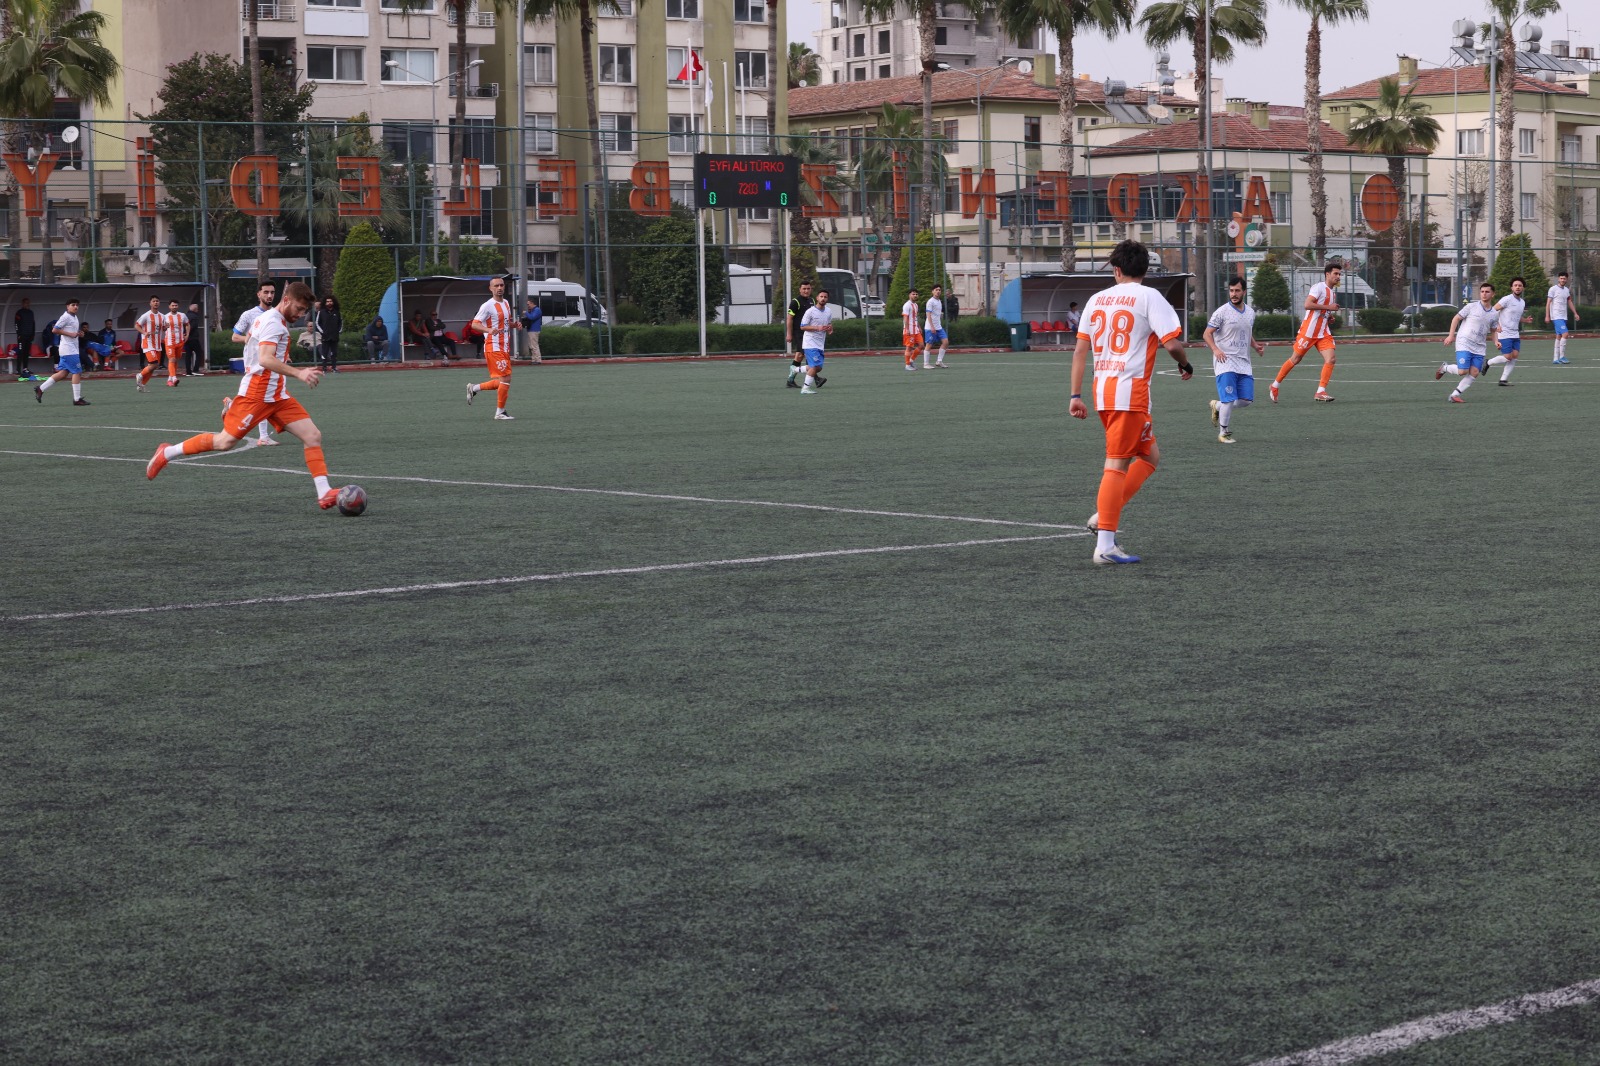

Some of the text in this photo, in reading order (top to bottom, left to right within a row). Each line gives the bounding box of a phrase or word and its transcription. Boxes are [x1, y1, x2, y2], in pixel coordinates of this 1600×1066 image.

[709, 191, 787, 205] 0 0
[1115, 296, 1137, 308] KAAN
[1089, 309, 1135, 356] 28
[1297, 337, 1309, 349] 44
[240, 413, 254, 427] 4
[1140, 421, 1153, 440] 2
